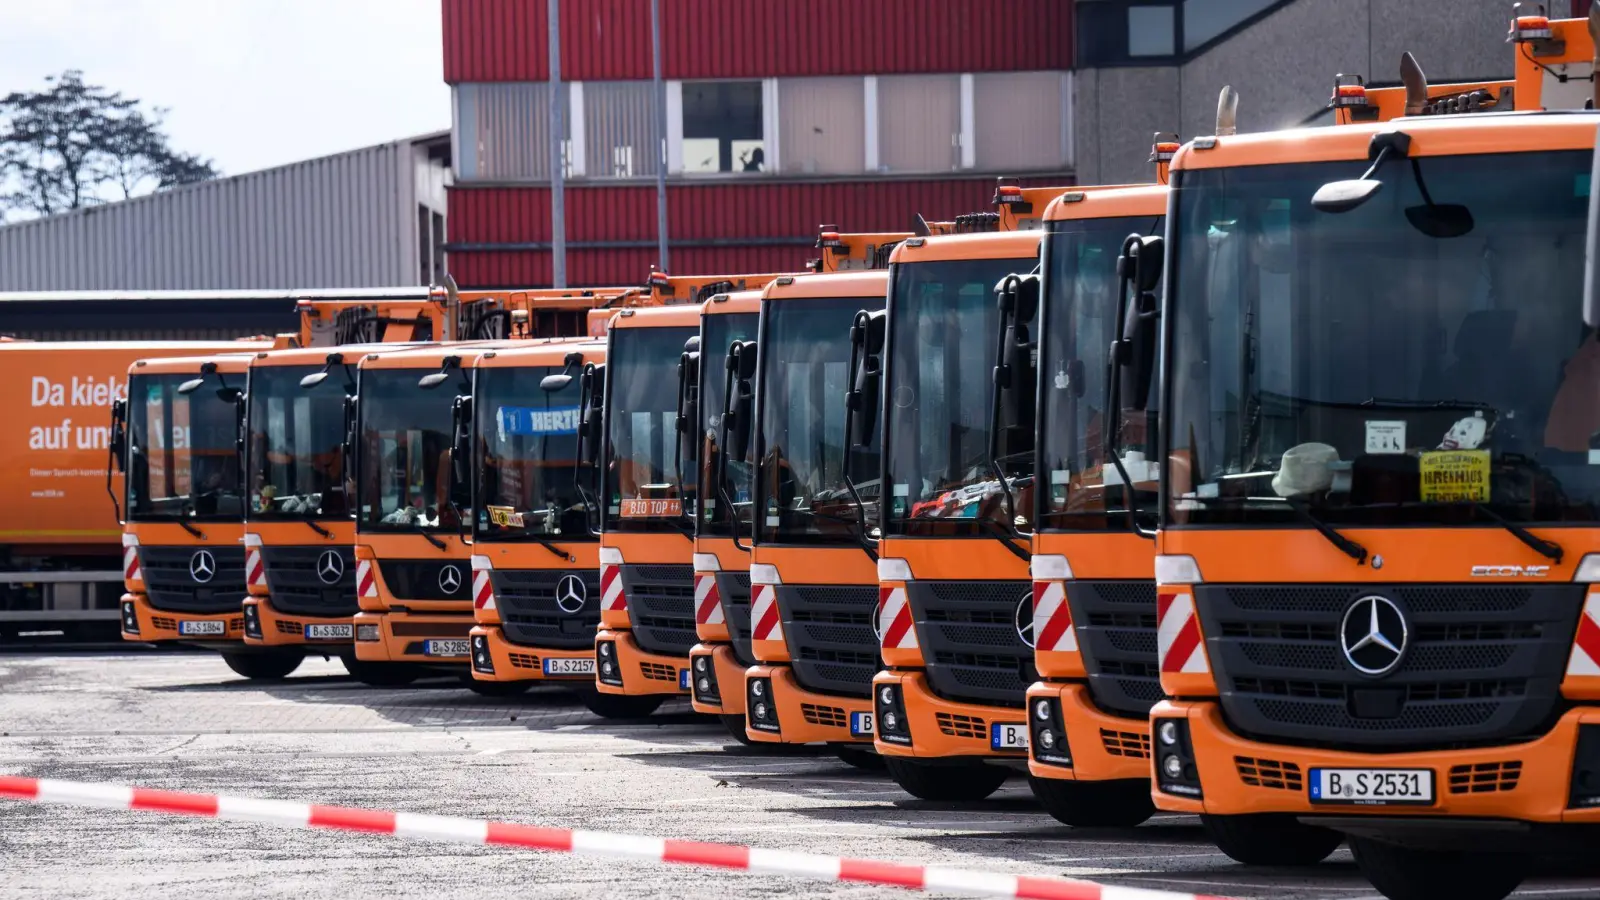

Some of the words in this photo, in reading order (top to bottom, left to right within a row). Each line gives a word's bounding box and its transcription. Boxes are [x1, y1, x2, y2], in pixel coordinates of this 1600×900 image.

[31, 376, 64, 407] Da
[29, 418, 71, 450] auf
[630, 501, 647, 514] BIO
[650, 501, 668, 514] TOP
[1471, 565, 1550, 577] ECONIC
[313, 626, 319, 636] B
[432, 641, 439, 653] B
[552, 660, 558, 671] B
[863, 715, 873, 731] B
[1006, 727, 1016, 744] B
[1329, 773, 1342, 795] B
